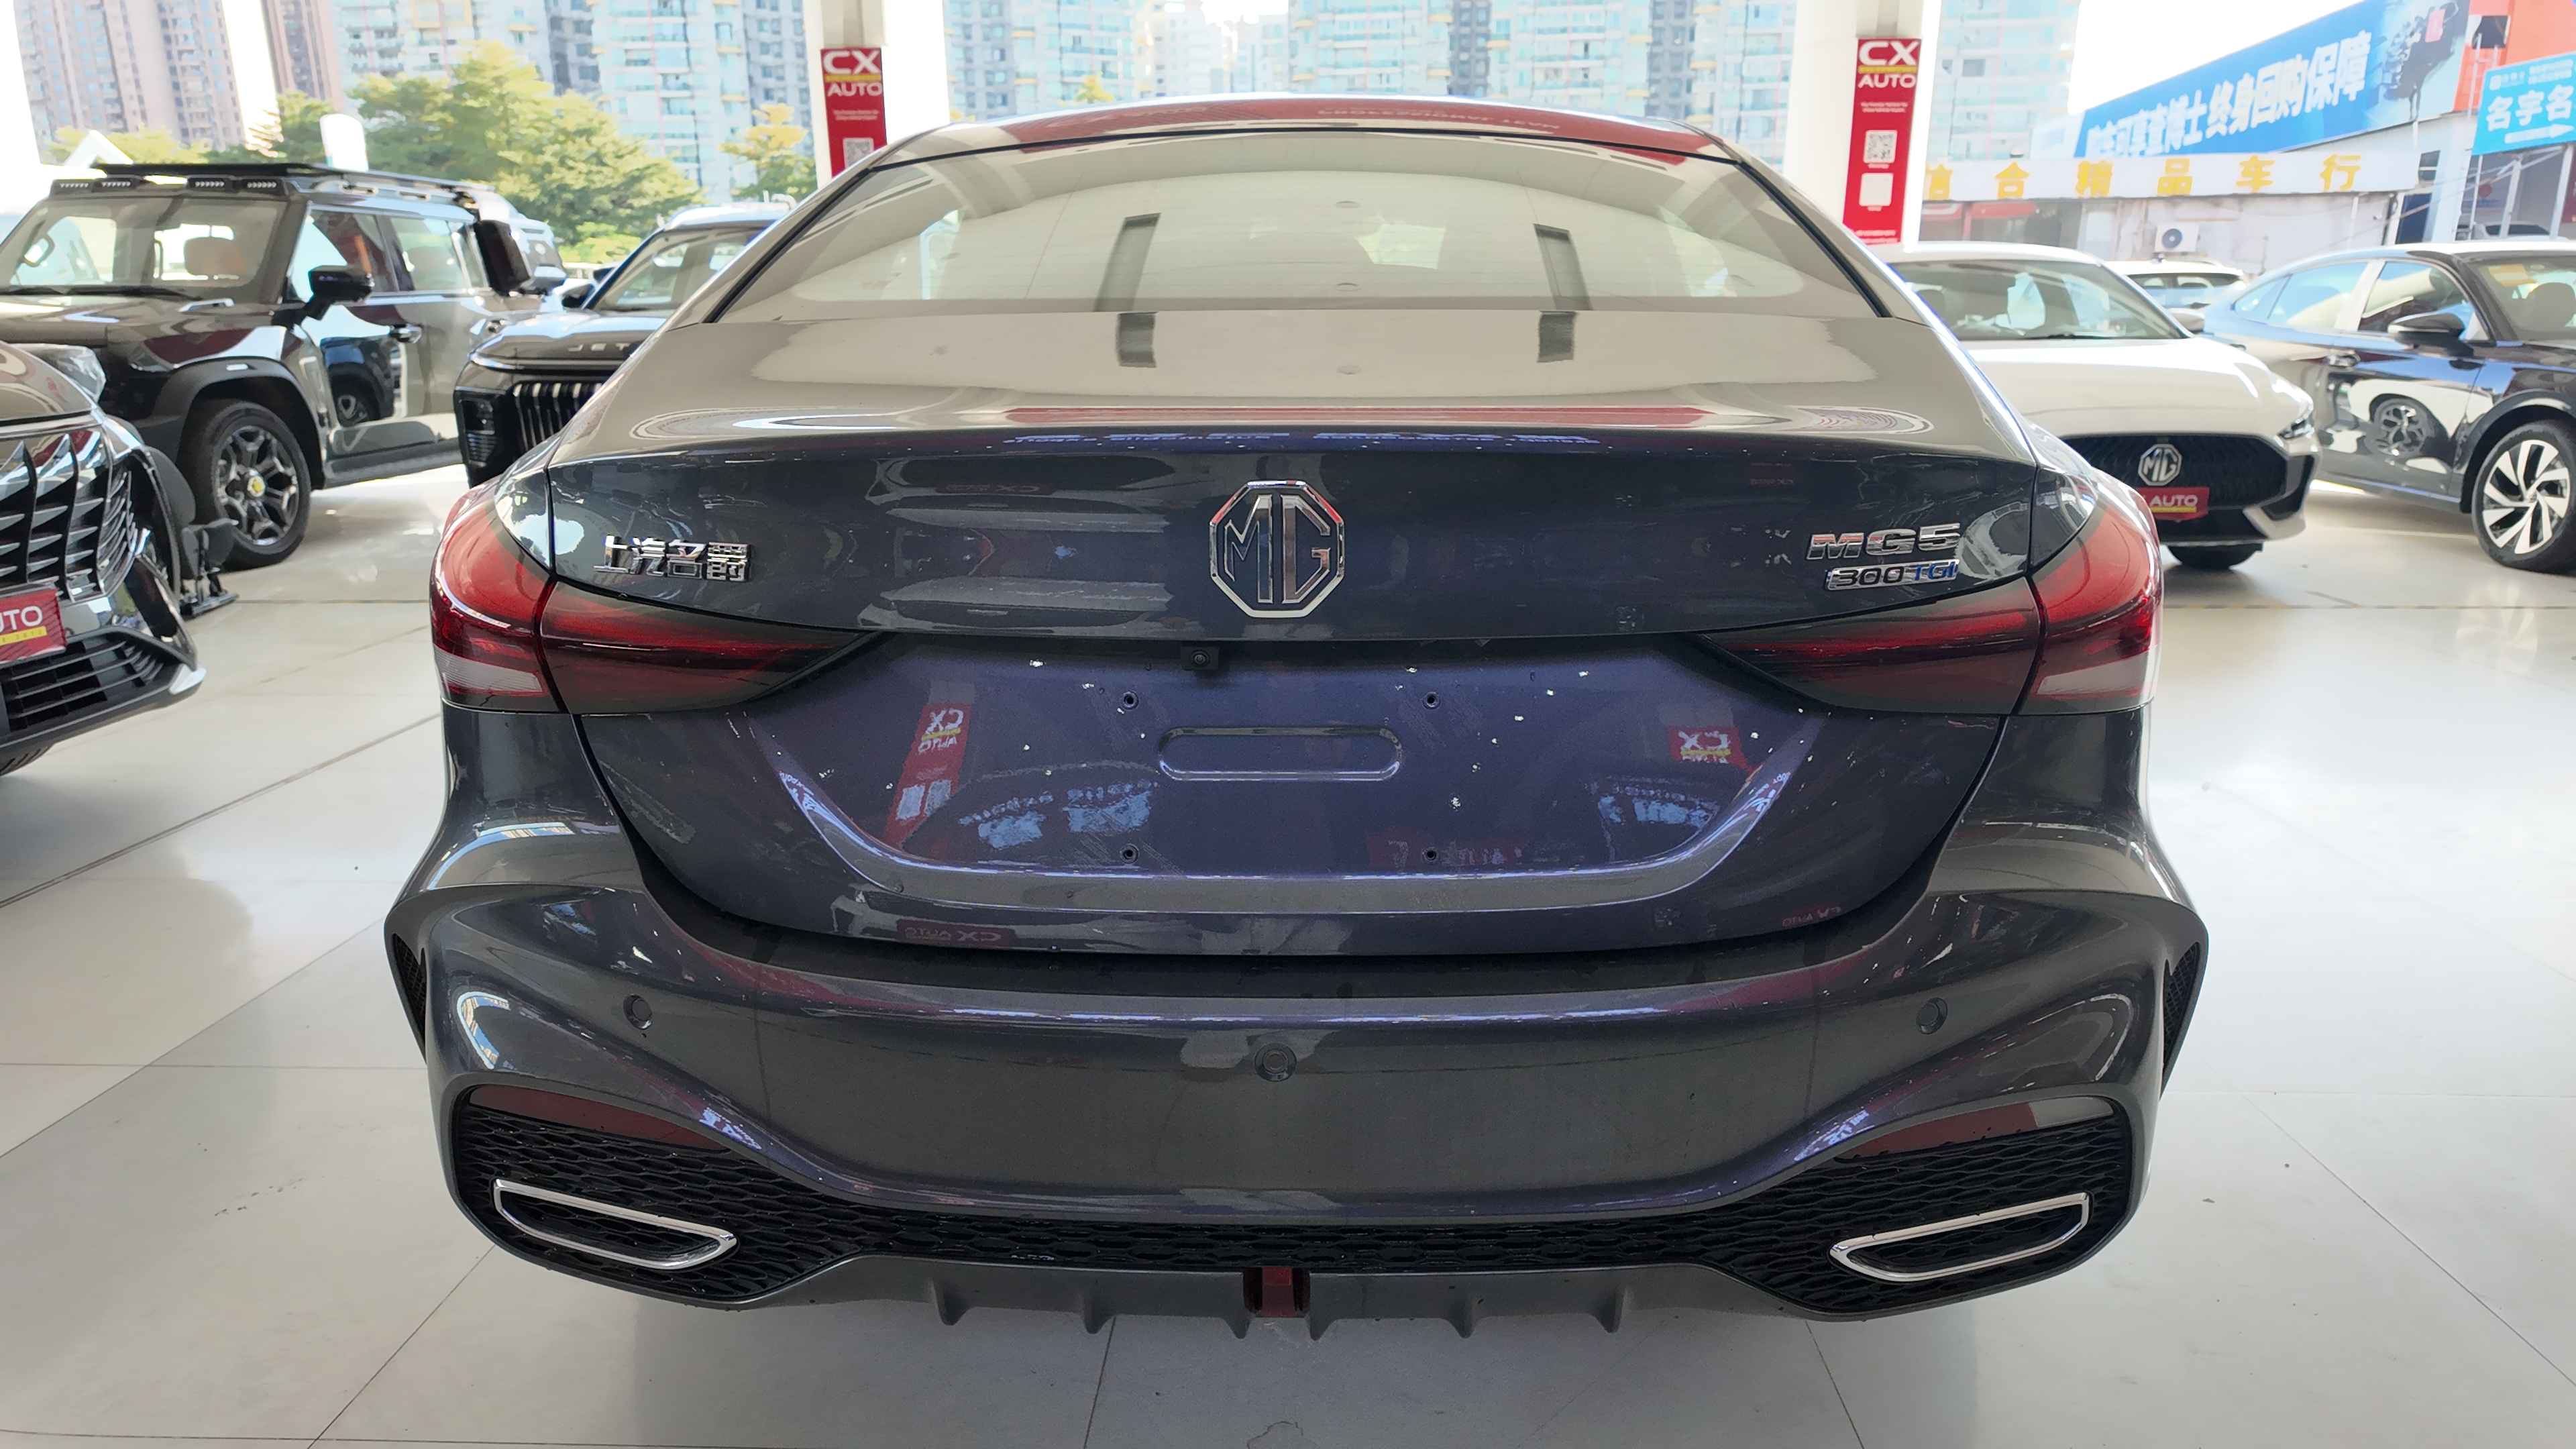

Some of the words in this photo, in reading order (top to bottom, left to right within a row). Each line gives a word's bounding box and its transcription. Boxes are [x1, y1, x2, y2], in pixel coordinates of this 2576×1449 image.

[823, 50, 881, 74] CX
[1859, 40, 1919, 66] CX
[827, 82, 883, 97] AUTO
[1858, 73, 1917, 89] AUTO
[2142, 447, 2179, 482] MG
[2149, 494, 2198, 507] AUTO
[1224, 494, 1332, 604] MG
[1806, 522, 1962, 560] MG5
[593, 534, 749, 582] 上汽名爵
[1835, 561, 1958, 588] 300TGI
